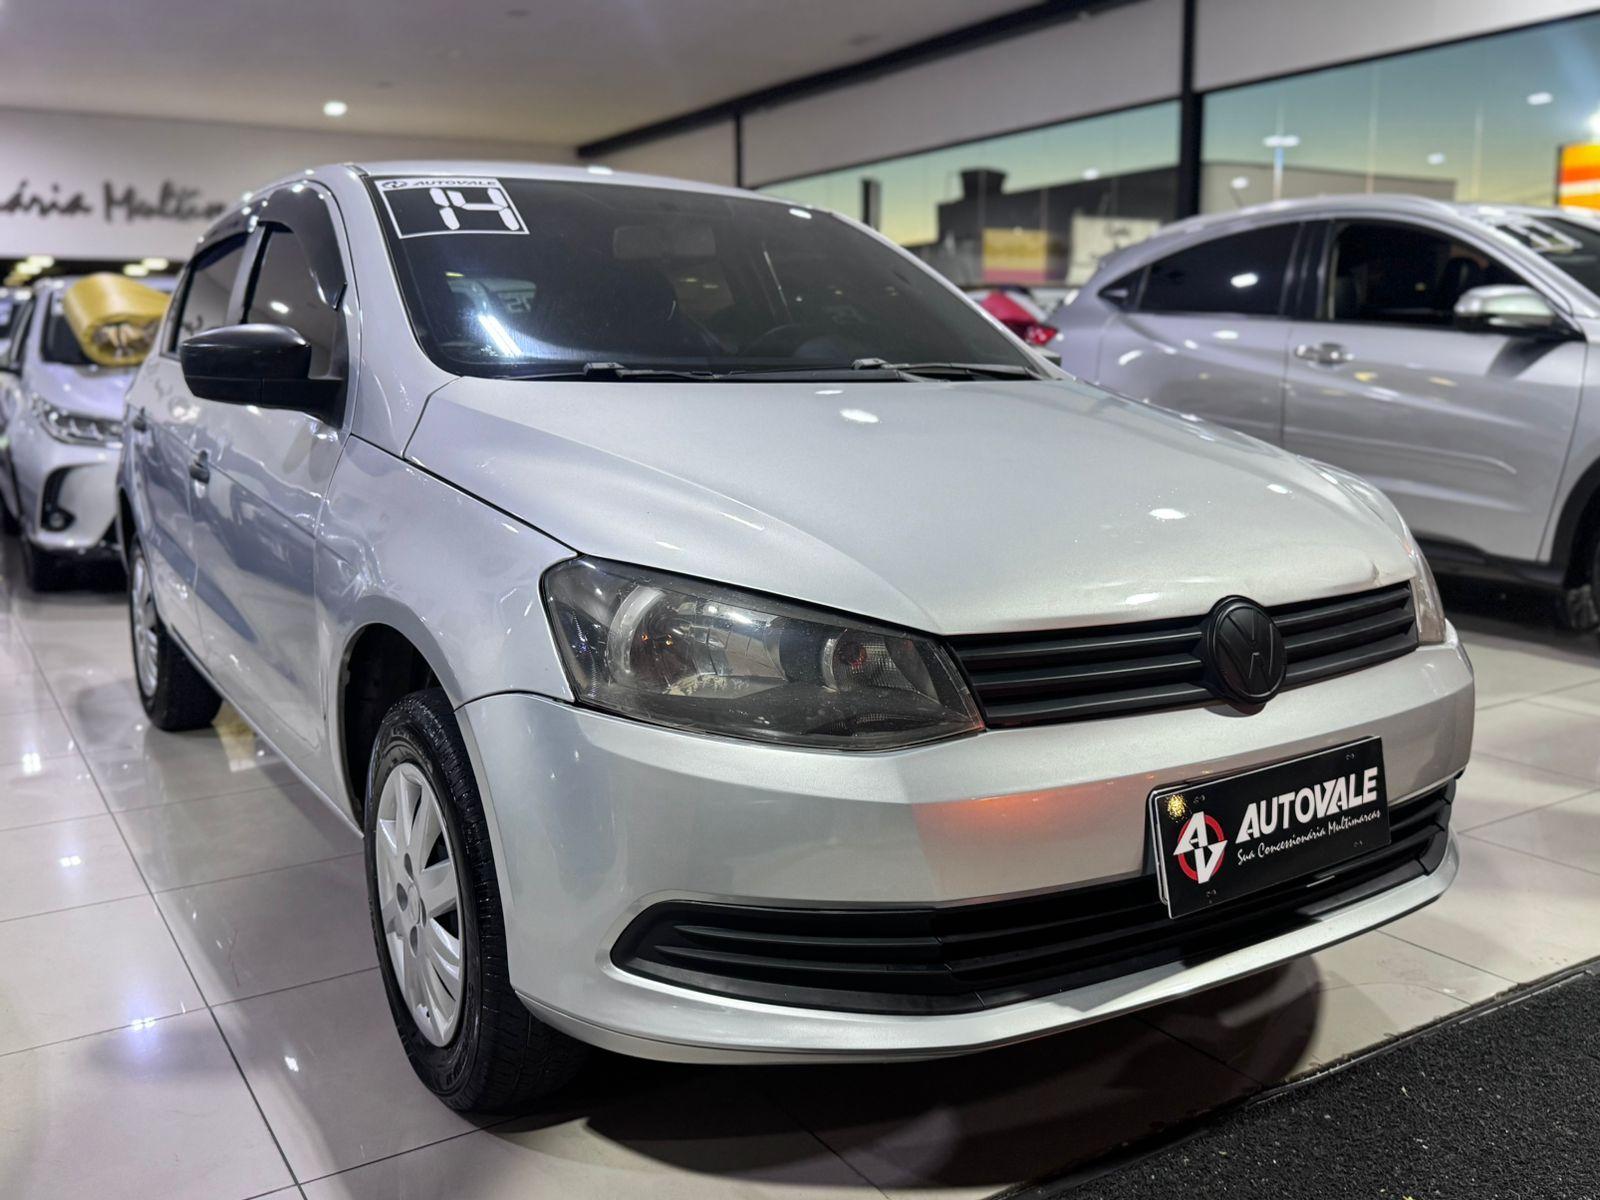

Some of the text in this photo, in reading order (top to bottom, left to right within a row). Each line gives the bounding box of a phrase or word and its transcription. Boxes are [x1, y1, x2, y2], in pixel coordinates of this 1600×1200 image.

[429, 187, 520, 231] 14
[1235, 767, 1378, 844] AUTOVALE
[1237, 808, 1382, 866] Sua Concessionária Multimarcas
